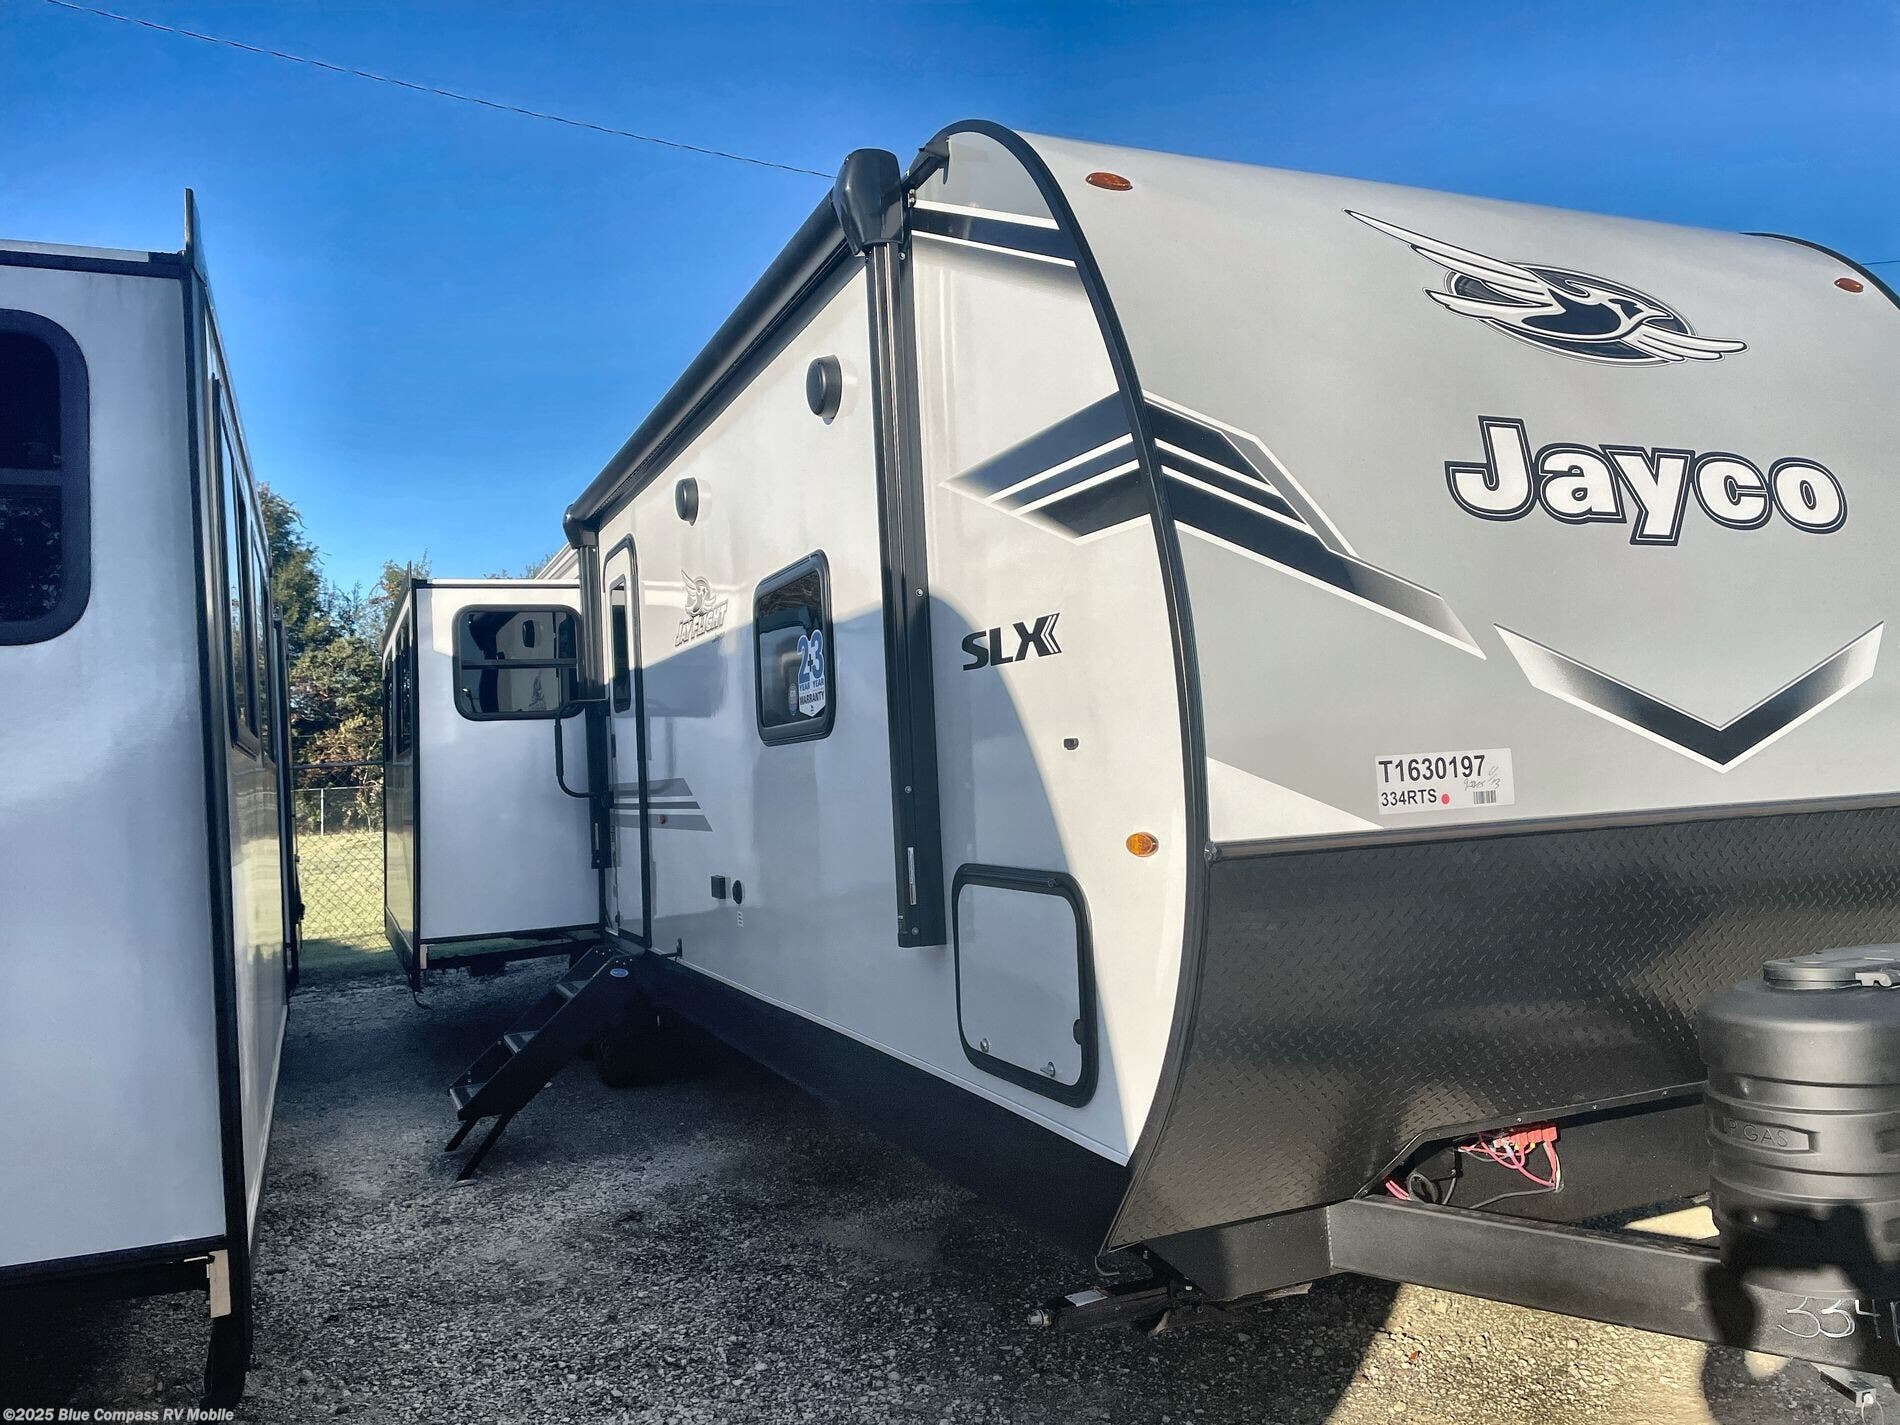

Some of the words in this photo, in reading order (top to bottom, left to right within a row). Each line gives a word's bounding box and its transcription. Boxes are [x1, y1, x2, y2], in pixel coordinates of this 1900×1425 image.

[1444, 415, 1848, 546] Jayco
[961, 612, 1063, 671] SLX
[800, 690, 825, 706] WARRANTY
[1378, 755, 1485, 783] T1630197
[1381, 788, 1437, 807] 334RTS
[1743, 1123, 1788, 1148] GAS
